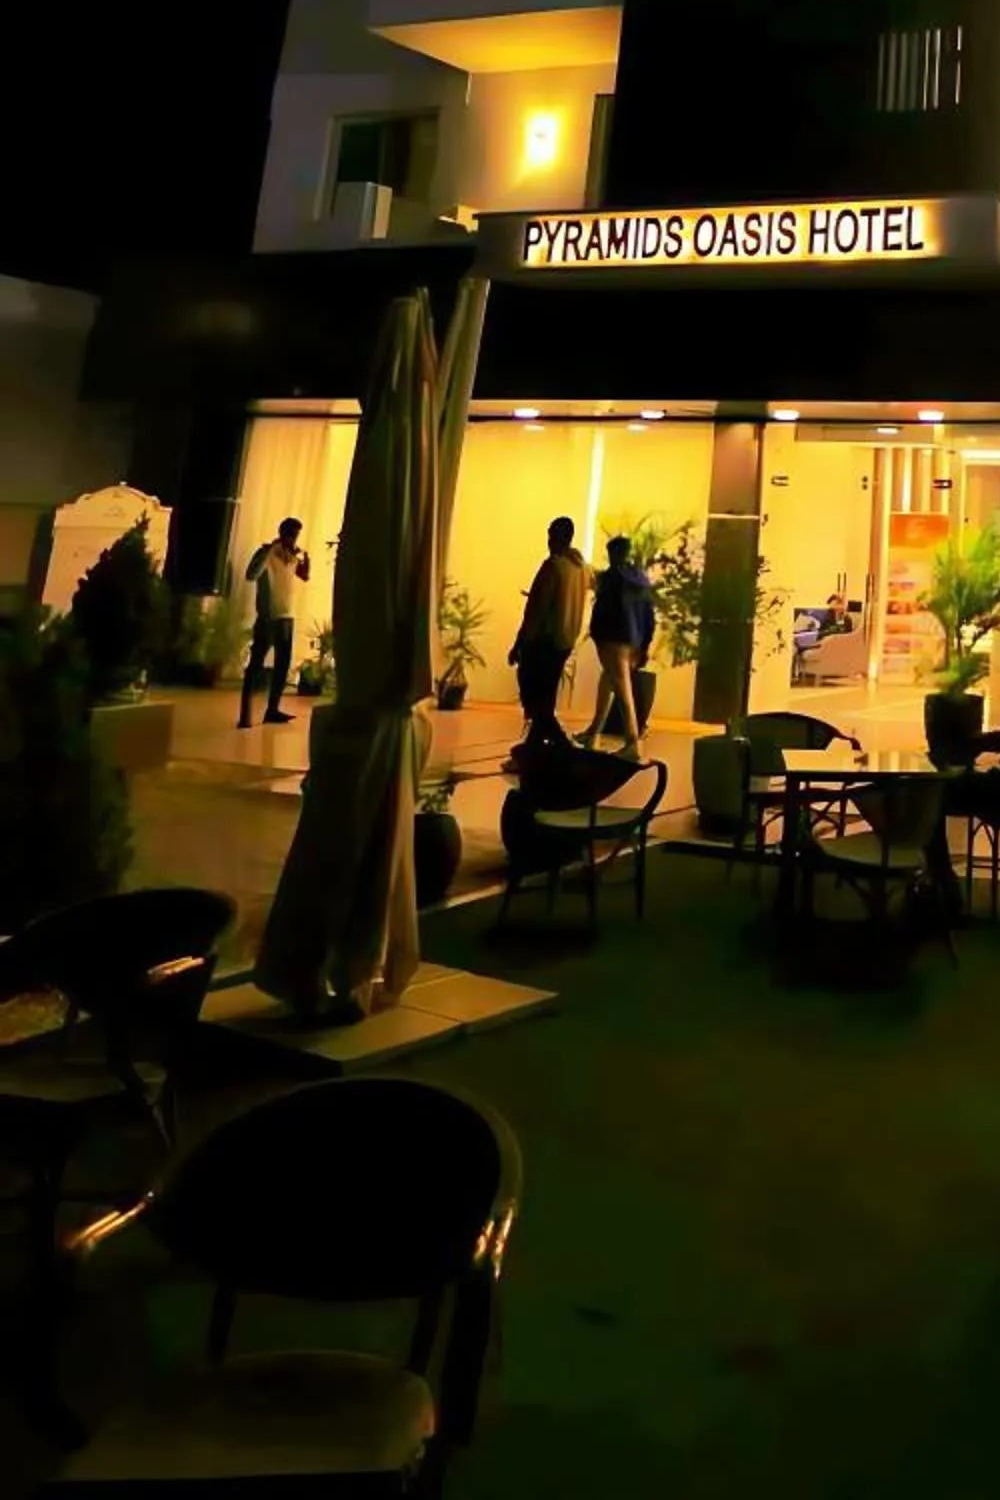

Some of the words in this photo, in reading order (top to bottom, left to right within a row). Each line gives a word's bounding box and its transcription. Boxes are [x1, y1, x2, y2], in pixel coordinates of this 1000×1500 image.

[523, 214, 684, 261] PYRAMIDS
[693, 211, 797, 257] OASIS
[808, 206, 925, 254] HOTEL
